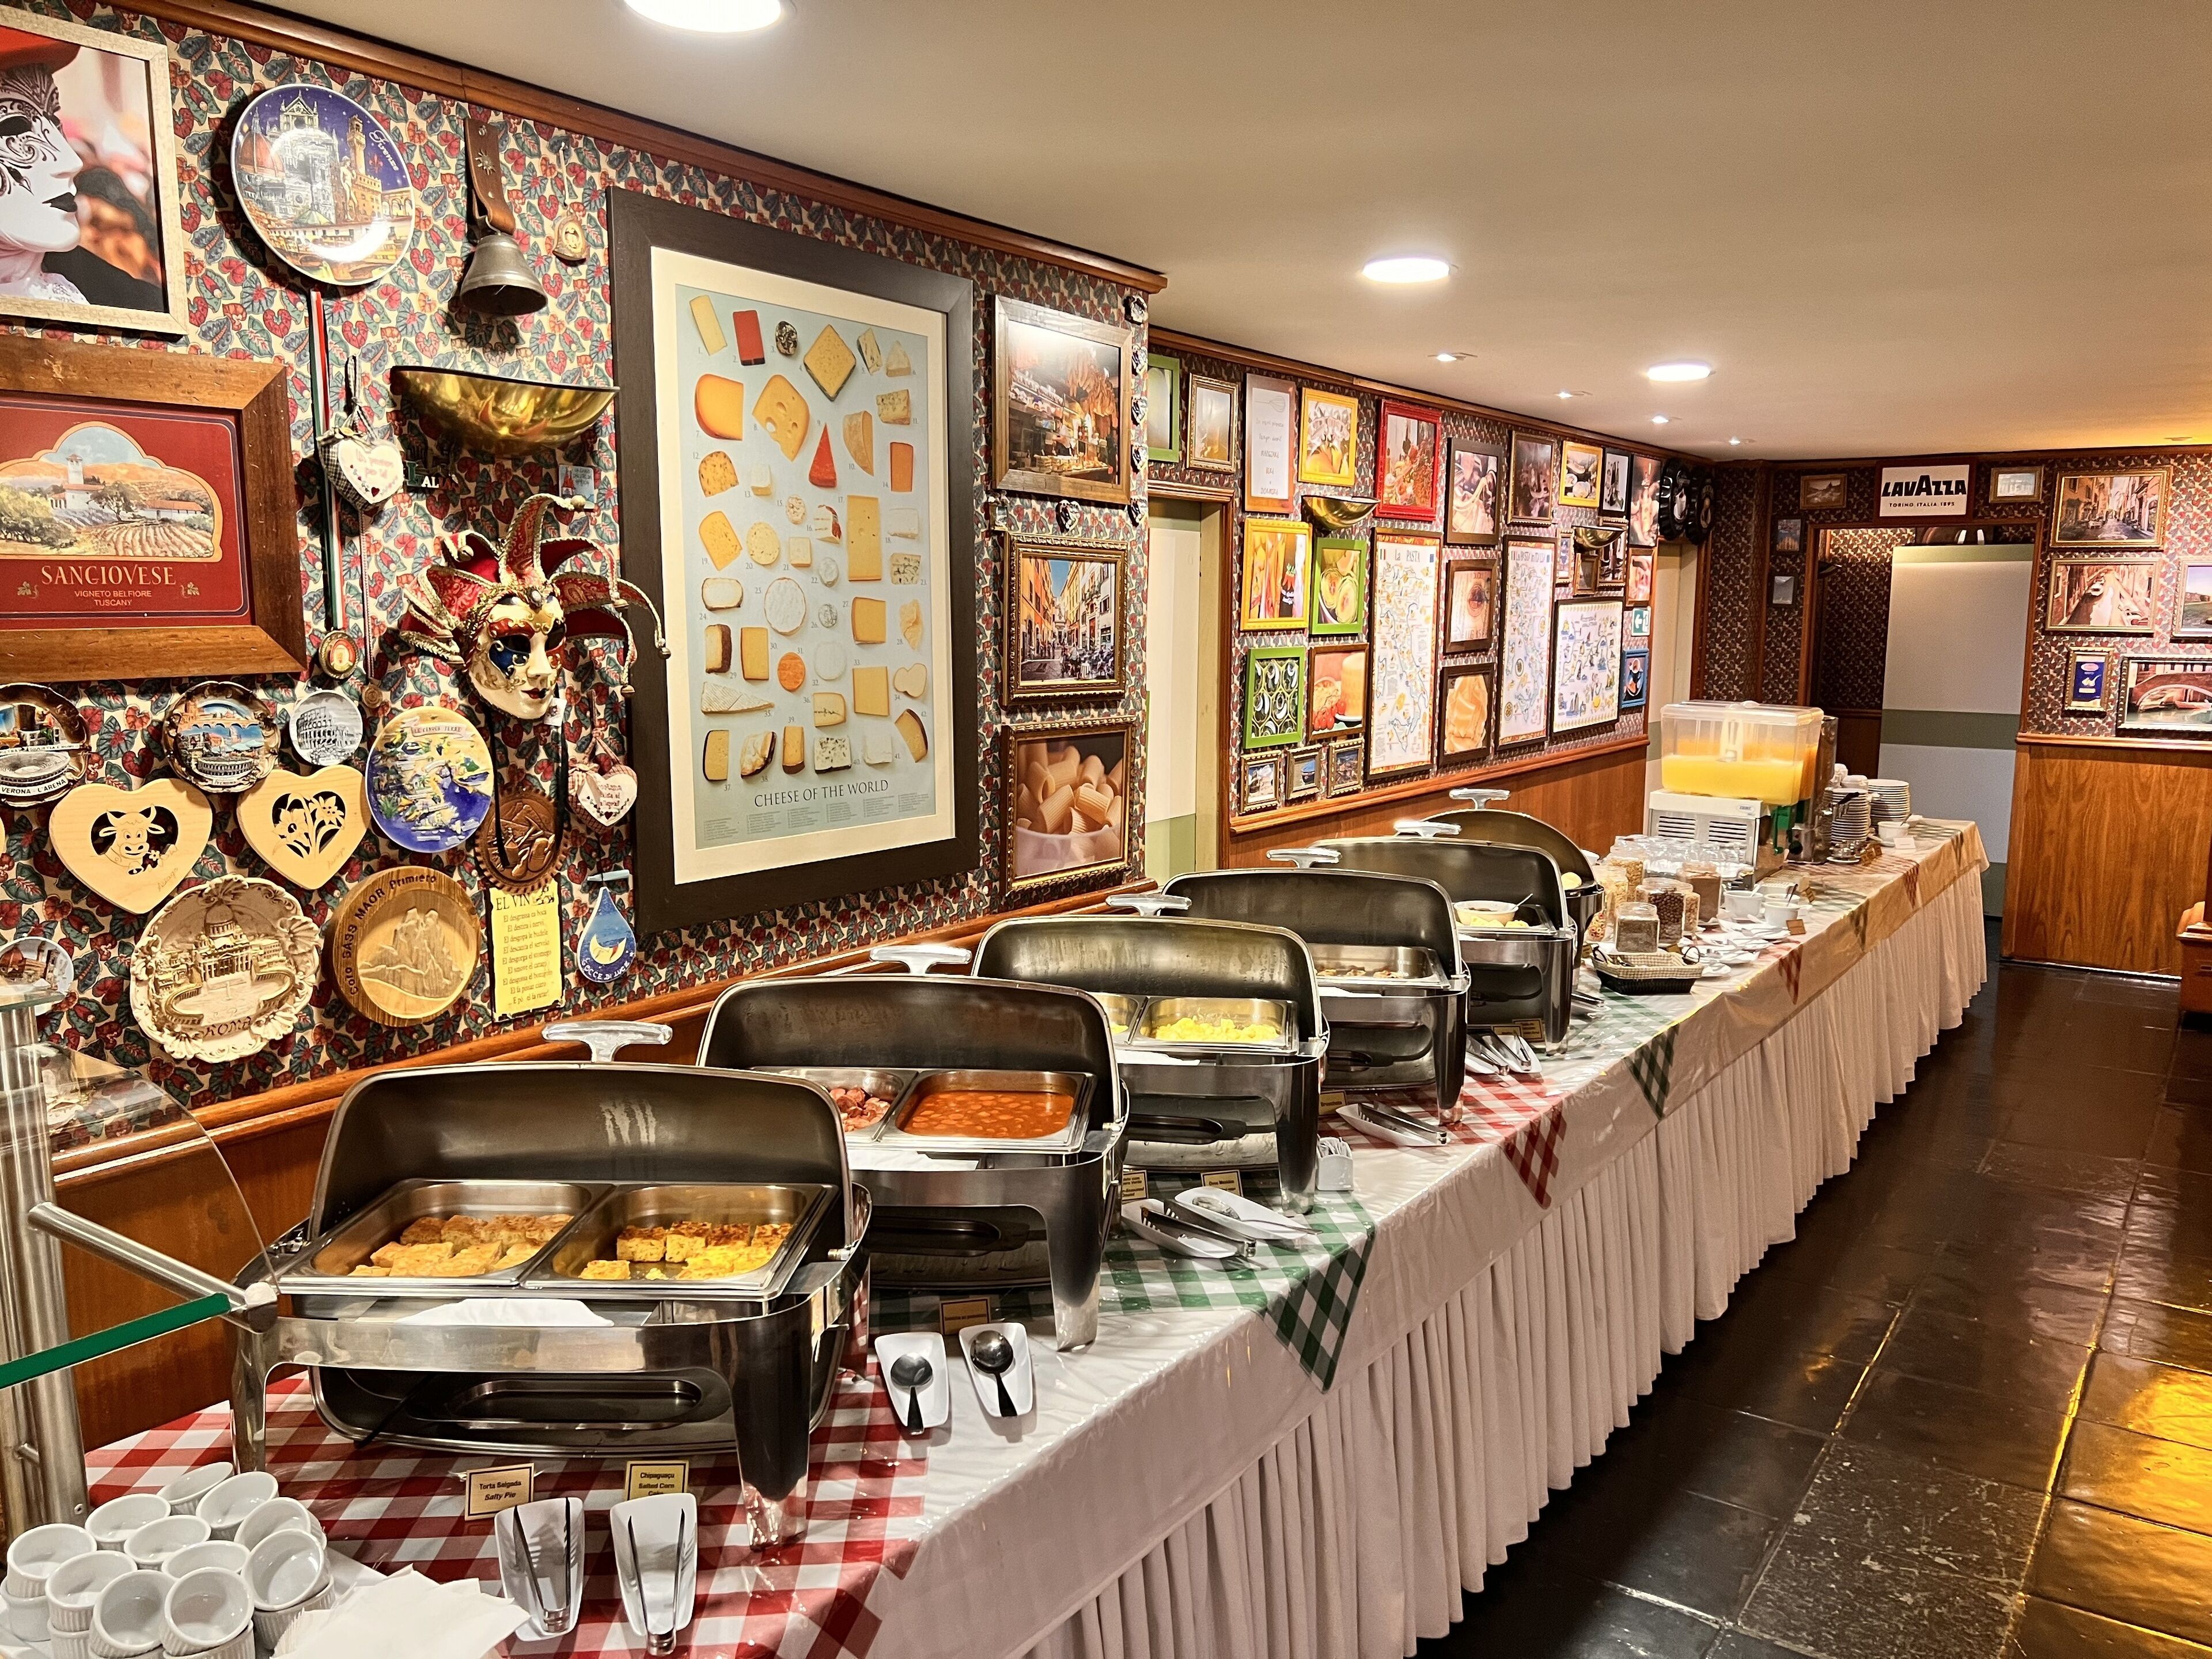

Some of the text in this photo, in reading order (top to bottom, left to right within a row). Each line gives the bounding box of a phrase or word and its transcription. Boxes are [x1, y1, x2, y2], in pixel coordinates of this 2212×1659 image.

[369, 130, 399, 171] Firenze
[1881, 475, 1967, 497] LAVAZZA
[1395, 549, 1420, 562] La PASTA
[41, 564, 176, 585] SANGIOVESE
[37, 779, 66, 793] L'ARENA
[754, 779, 888, 807] CHEESE OF THE WORLD
[354, 888, 385, 920] MAOR
[496, 896, 510, 911] EL
[581, 957, 603, 980] GOCCE
[613, 960, 630, 977] LUCE
[204, 1016, 251, 1037] ROMA
[497, 1480, 522, 1488] Salgada
